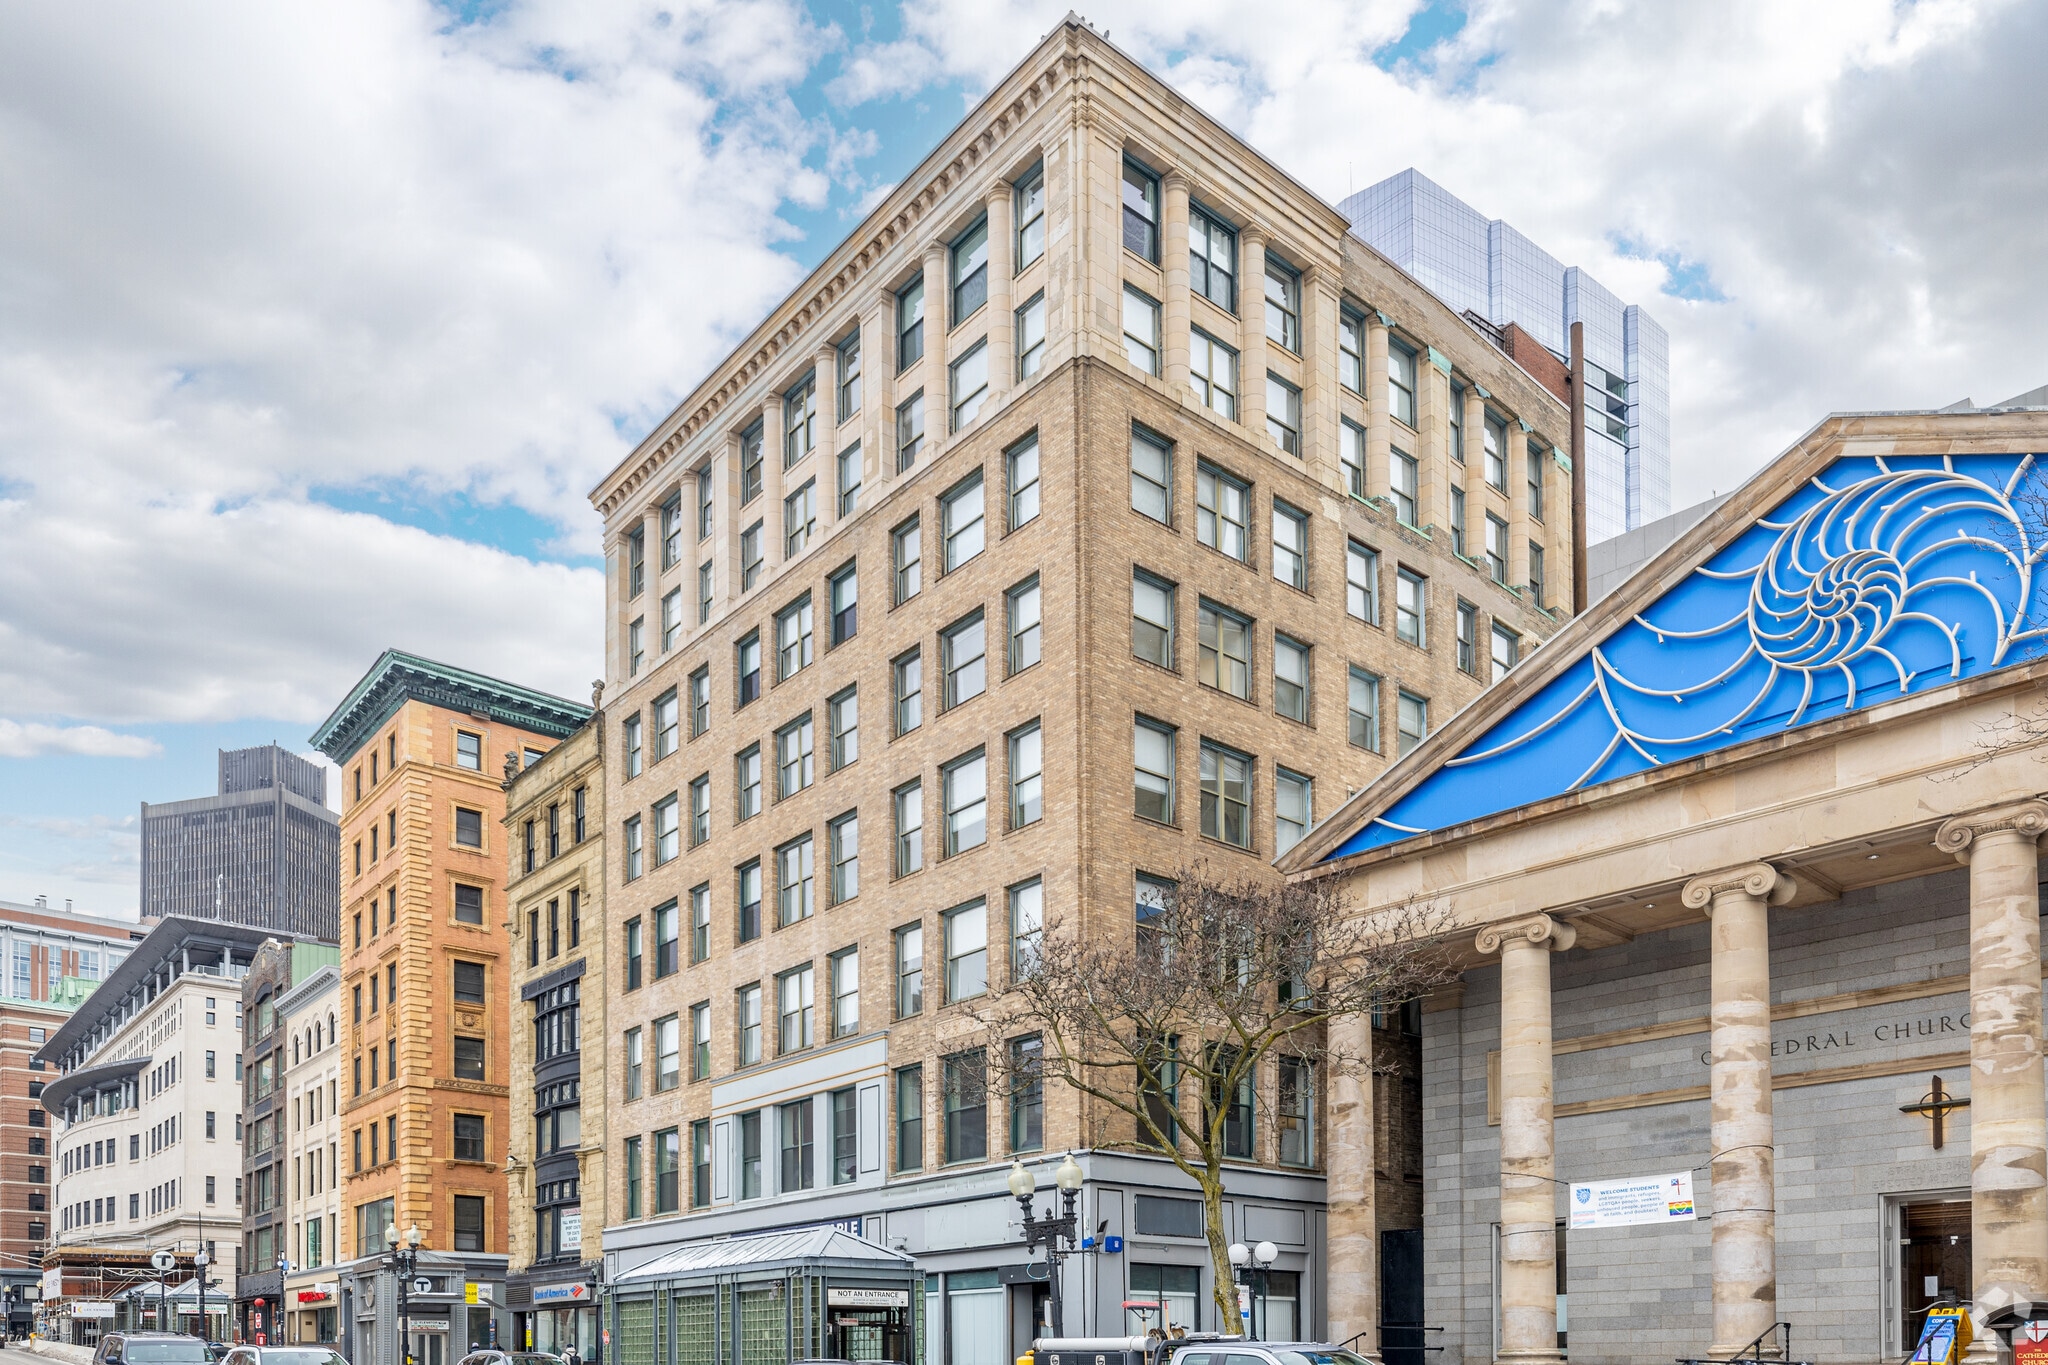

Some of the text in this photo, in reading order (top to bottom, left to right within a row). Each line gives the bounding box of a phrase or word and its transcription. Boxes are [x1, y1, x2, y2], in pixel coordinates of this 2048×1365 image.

[1701, 1012, 1971, 1066] CEDRAL CHURC
[156, 1255, 171, 1266] T
[416, 1281, 429, 1291] T
[549, 1287, 568, 1298] America
